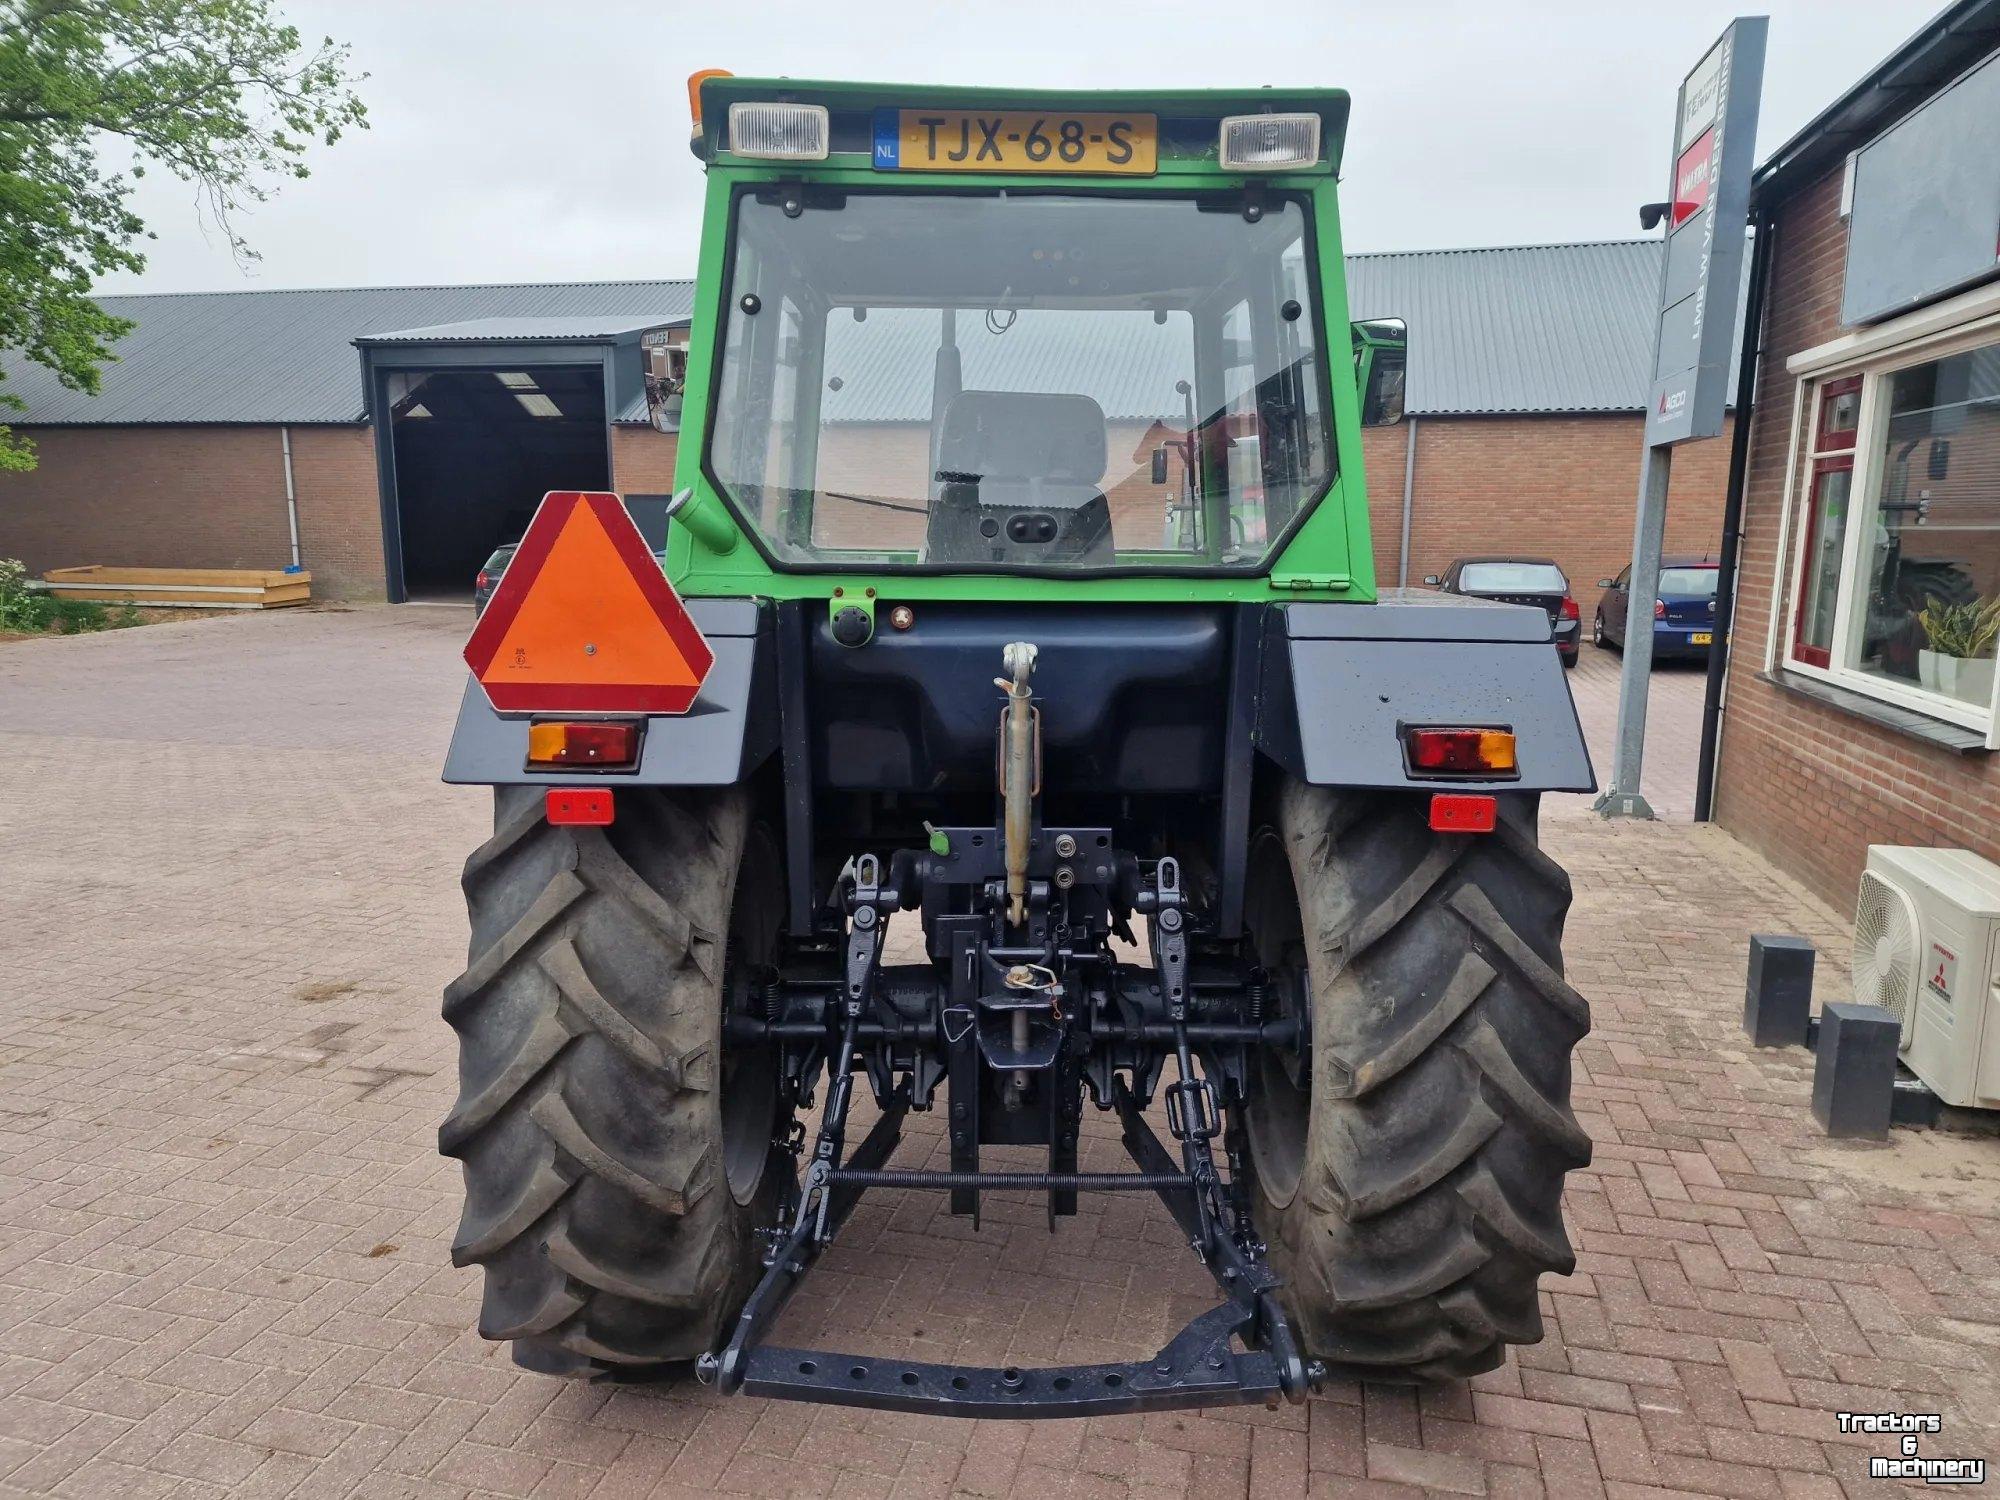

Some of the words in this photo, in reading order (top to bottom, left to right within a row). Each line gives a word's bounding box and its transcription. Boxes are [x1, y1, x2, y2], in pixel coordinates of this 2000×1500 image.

[877, 144, 895, 158] NL
[918, 118, 1133, 164] TJX-68-S
[1703, 193, 1715, 247] VAN
[1710, 128, 1722, 184] DEN
[1716, 37, 1731, 122] BRINK
